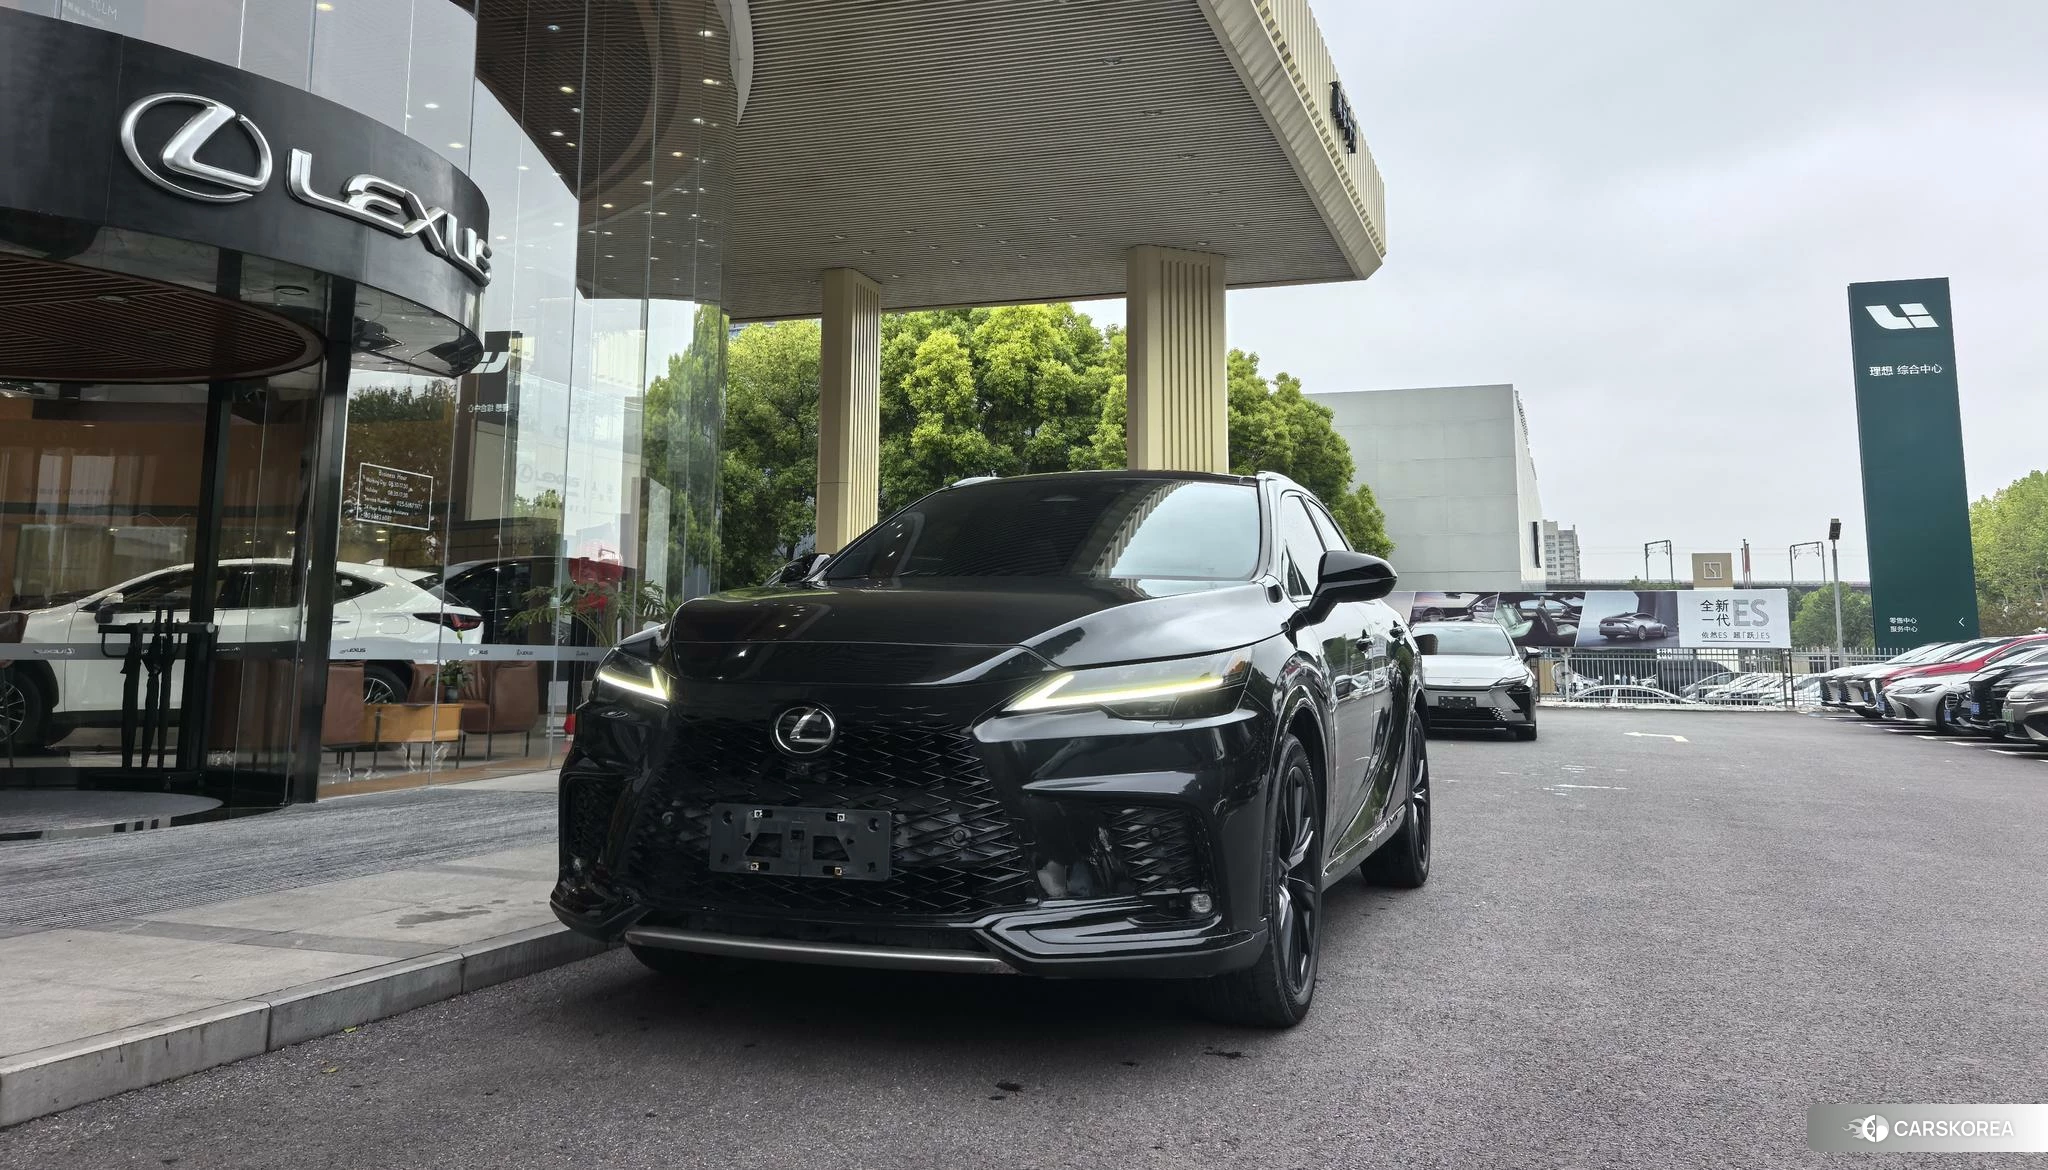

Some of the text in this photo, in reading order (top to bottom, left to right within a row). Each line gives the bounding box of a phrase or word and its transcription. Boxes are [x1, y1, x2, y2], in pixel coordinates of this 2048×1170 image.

[286, 147, 492, 287] LEXUS
[1869, 363, 1943, 377] 理想 综合中心
[1700, 599, 1730, 613] 全新
[1732, 598, 1770, 627] ES
[1701, 613, 1731, 627] 一代
